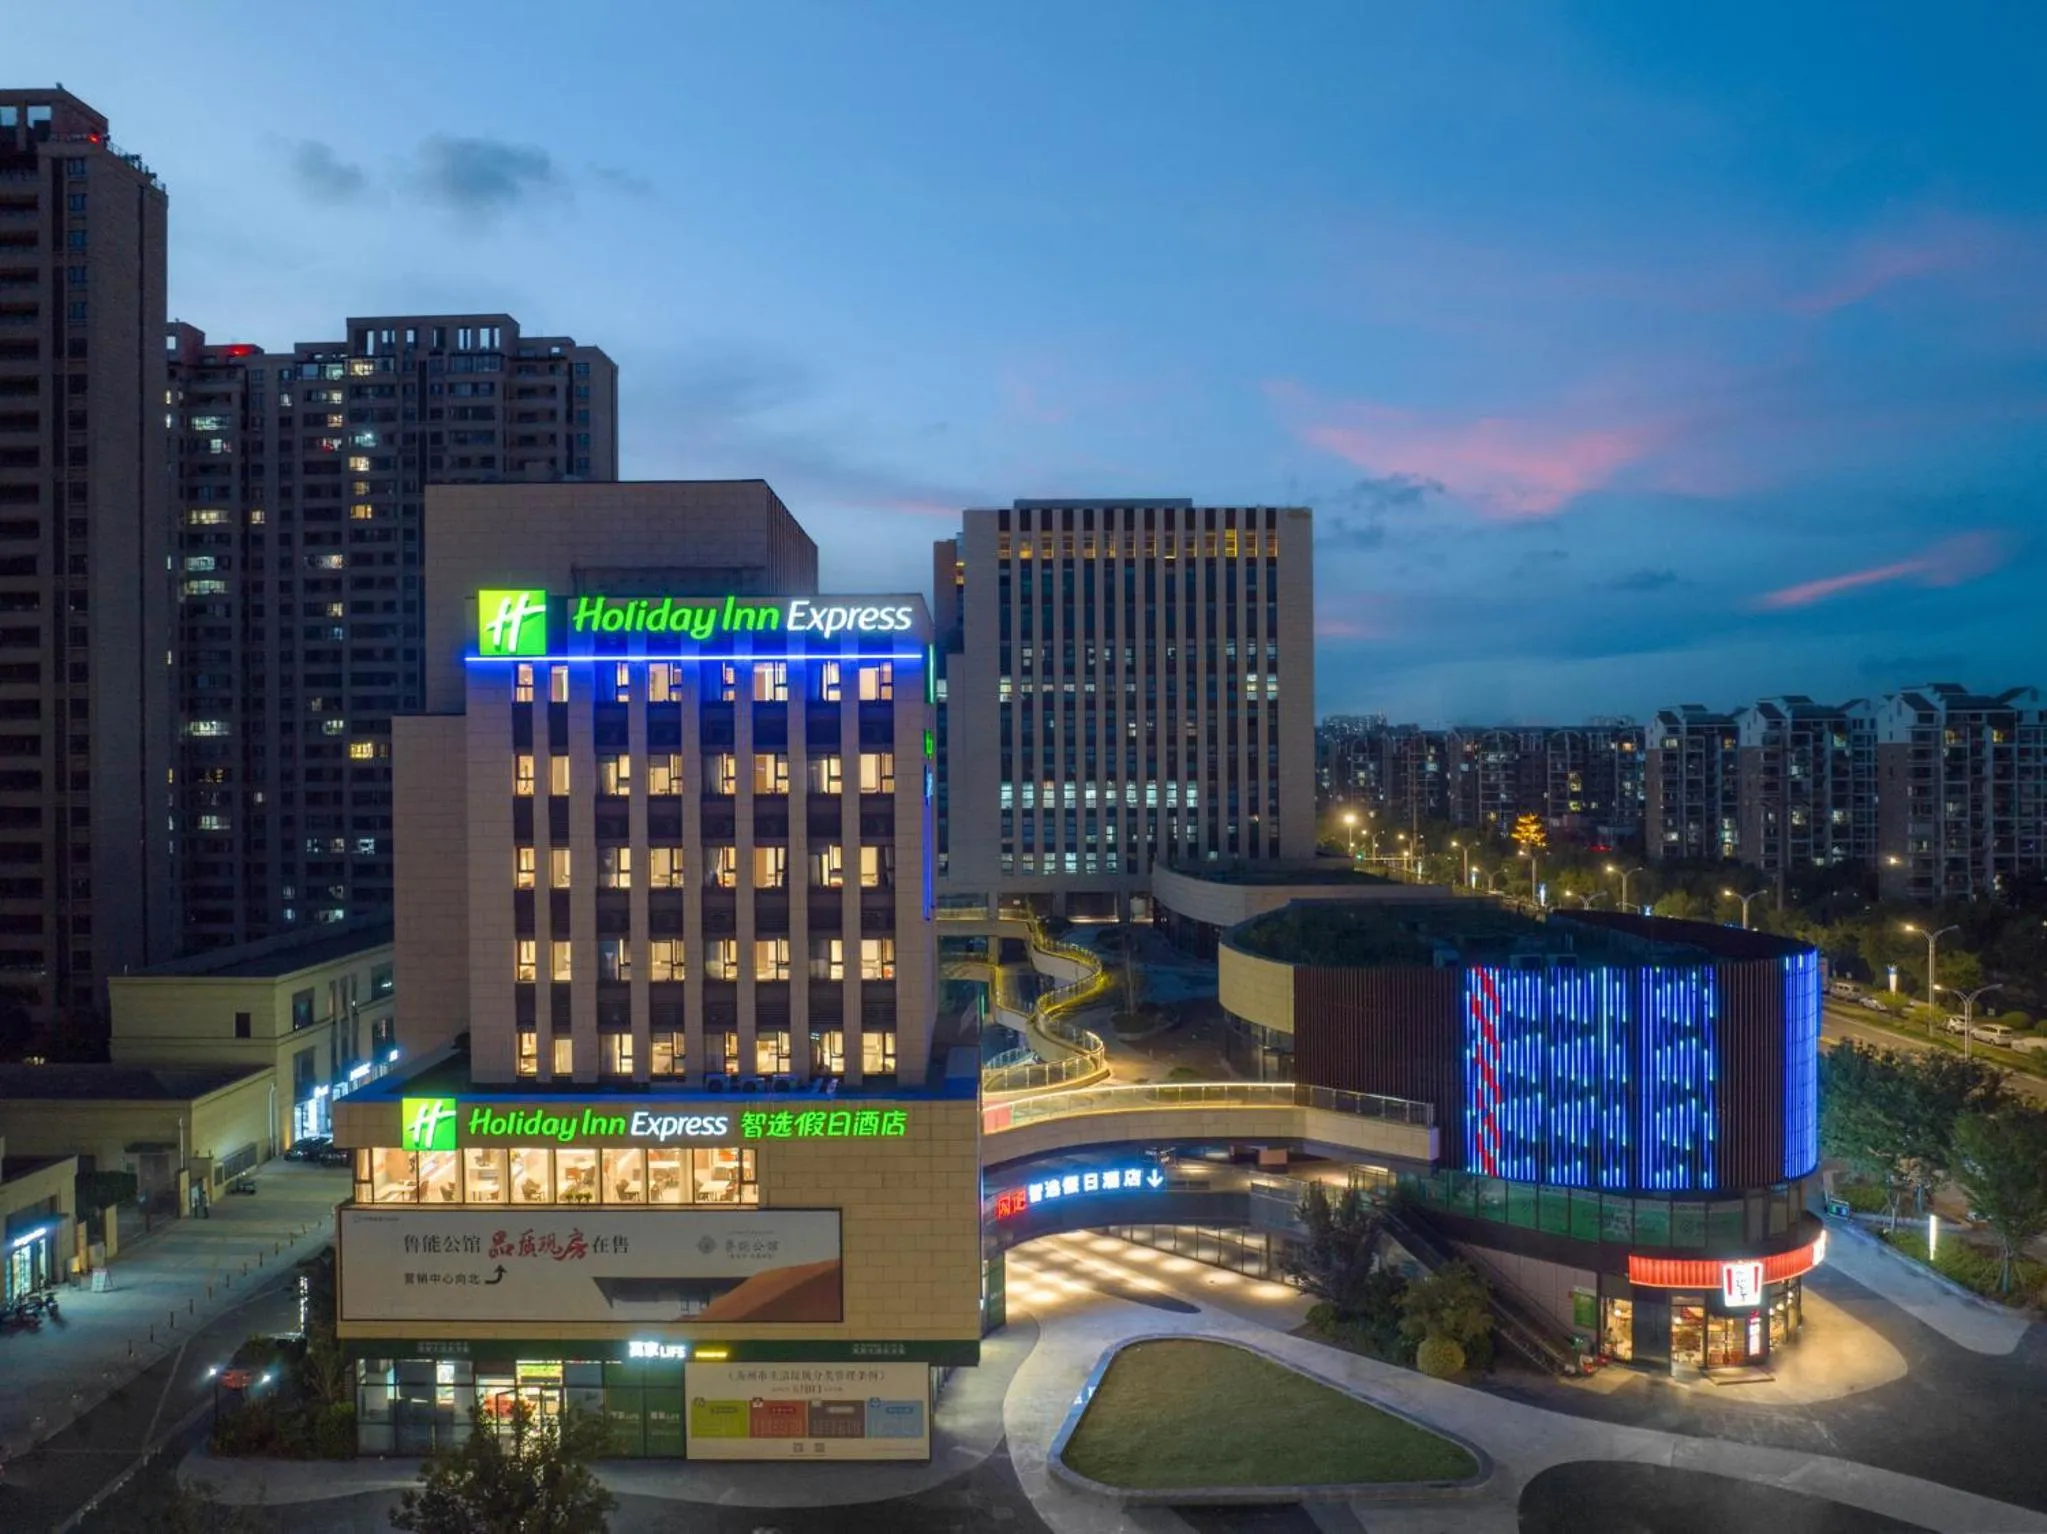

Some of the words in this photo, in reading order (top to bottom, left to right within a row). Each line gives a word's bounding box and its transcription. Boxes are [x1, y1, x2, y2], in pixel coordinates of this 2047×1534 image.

[572, 596, 716, 639] Holiday
[722, 596, 780, 631] Inn
[786, 600, 914, 639] Express
[468, 1108, 577, 1142] Holiday
[581, 1108, 626, 1136] Inn
[630, 1111, 728, 1142] Express
[739, 1110, 908, 1138] 智选假日酒店
